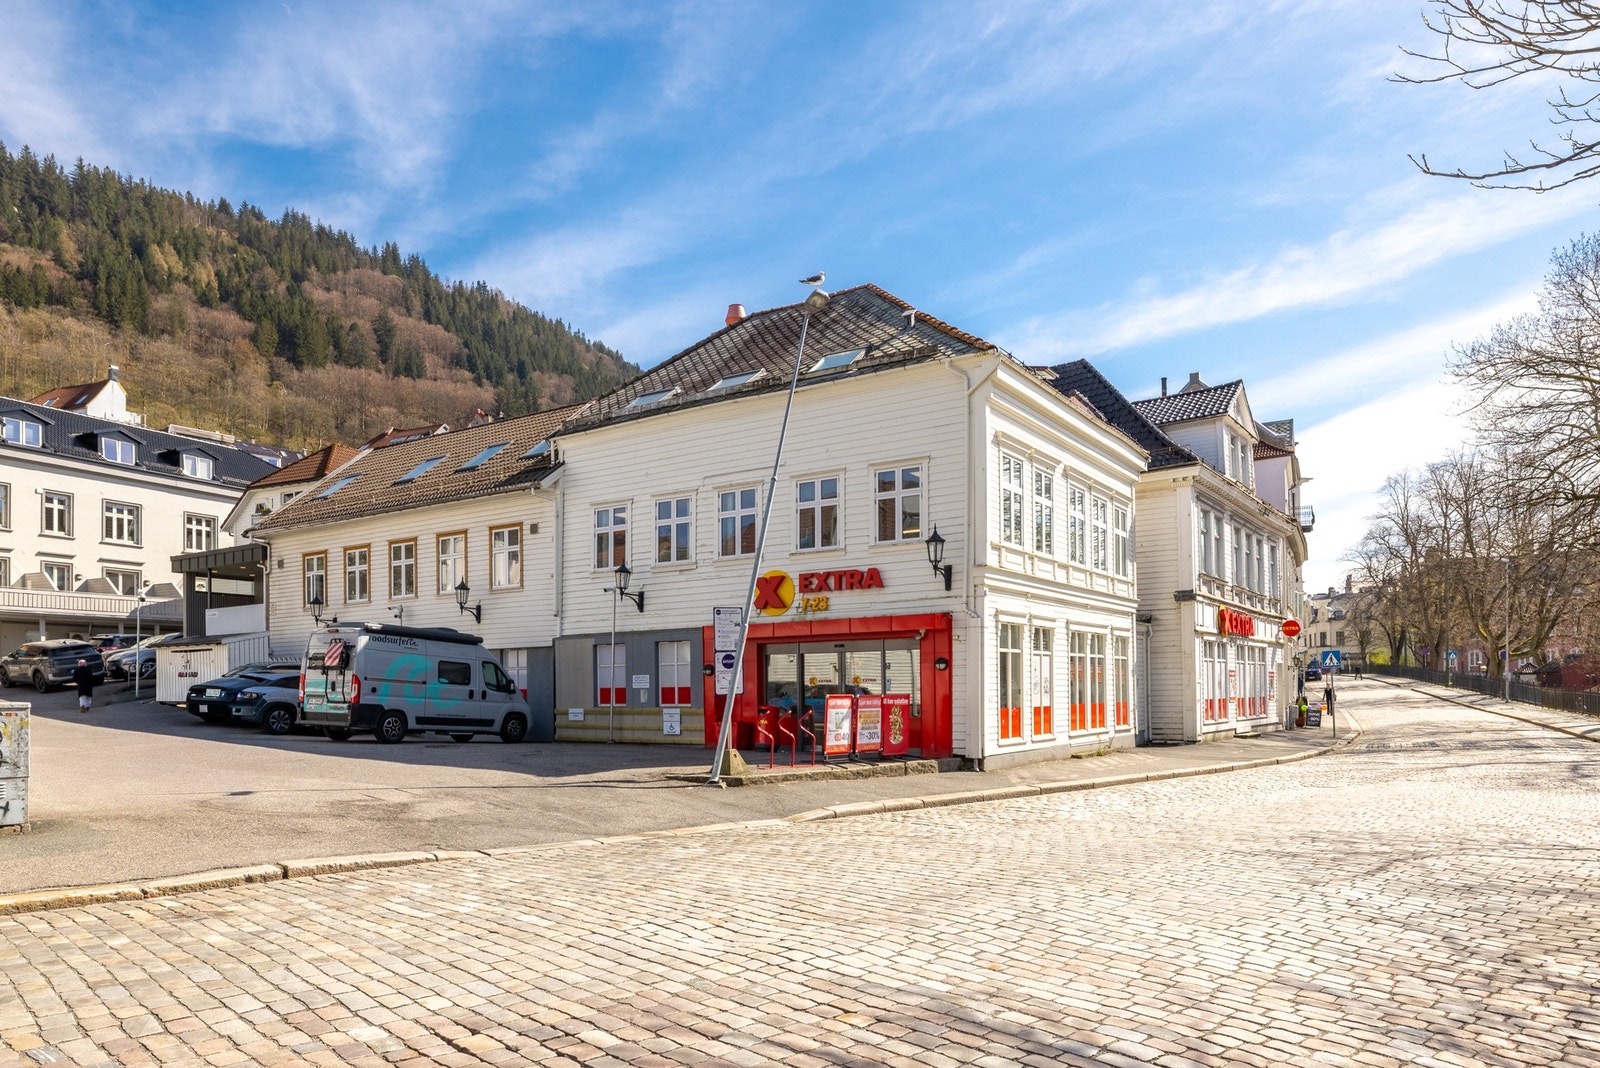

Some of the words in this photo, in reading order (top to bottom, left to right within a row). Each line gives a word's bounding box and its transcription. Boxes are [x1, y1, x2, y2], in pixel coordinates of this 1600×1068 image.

[799, 568, 884, 593] EXTRA
[801, 597, 828, 611] 7-23
[1232, 612, 1254, 636] EXTRA
[866, 731, 879, 740] -30%
